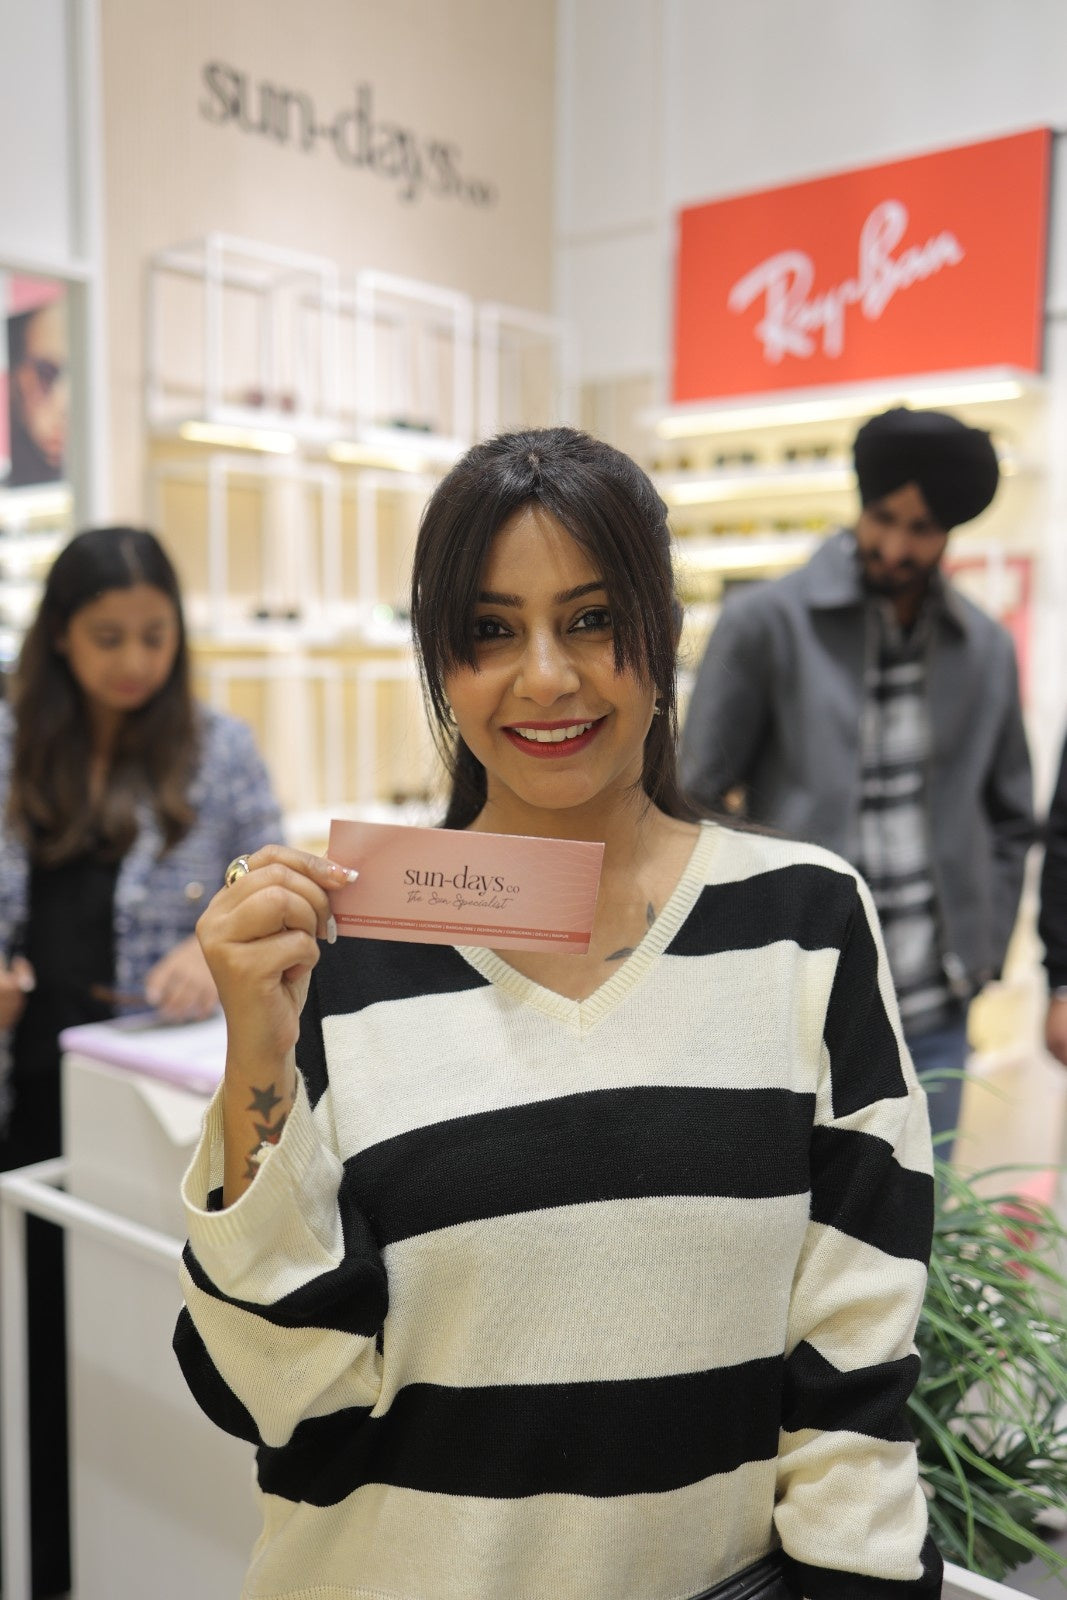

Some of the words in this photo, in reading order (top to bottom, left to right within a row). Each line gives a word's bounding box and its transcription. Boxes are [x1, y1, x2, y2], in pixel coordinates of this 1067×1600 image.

[727, 199, 964, 364] Ray-Ban
[403, 865, 504, 896] sun-days
[427, 891, 450, 905] Sun
[452, 894, 512, 910] Specialist
